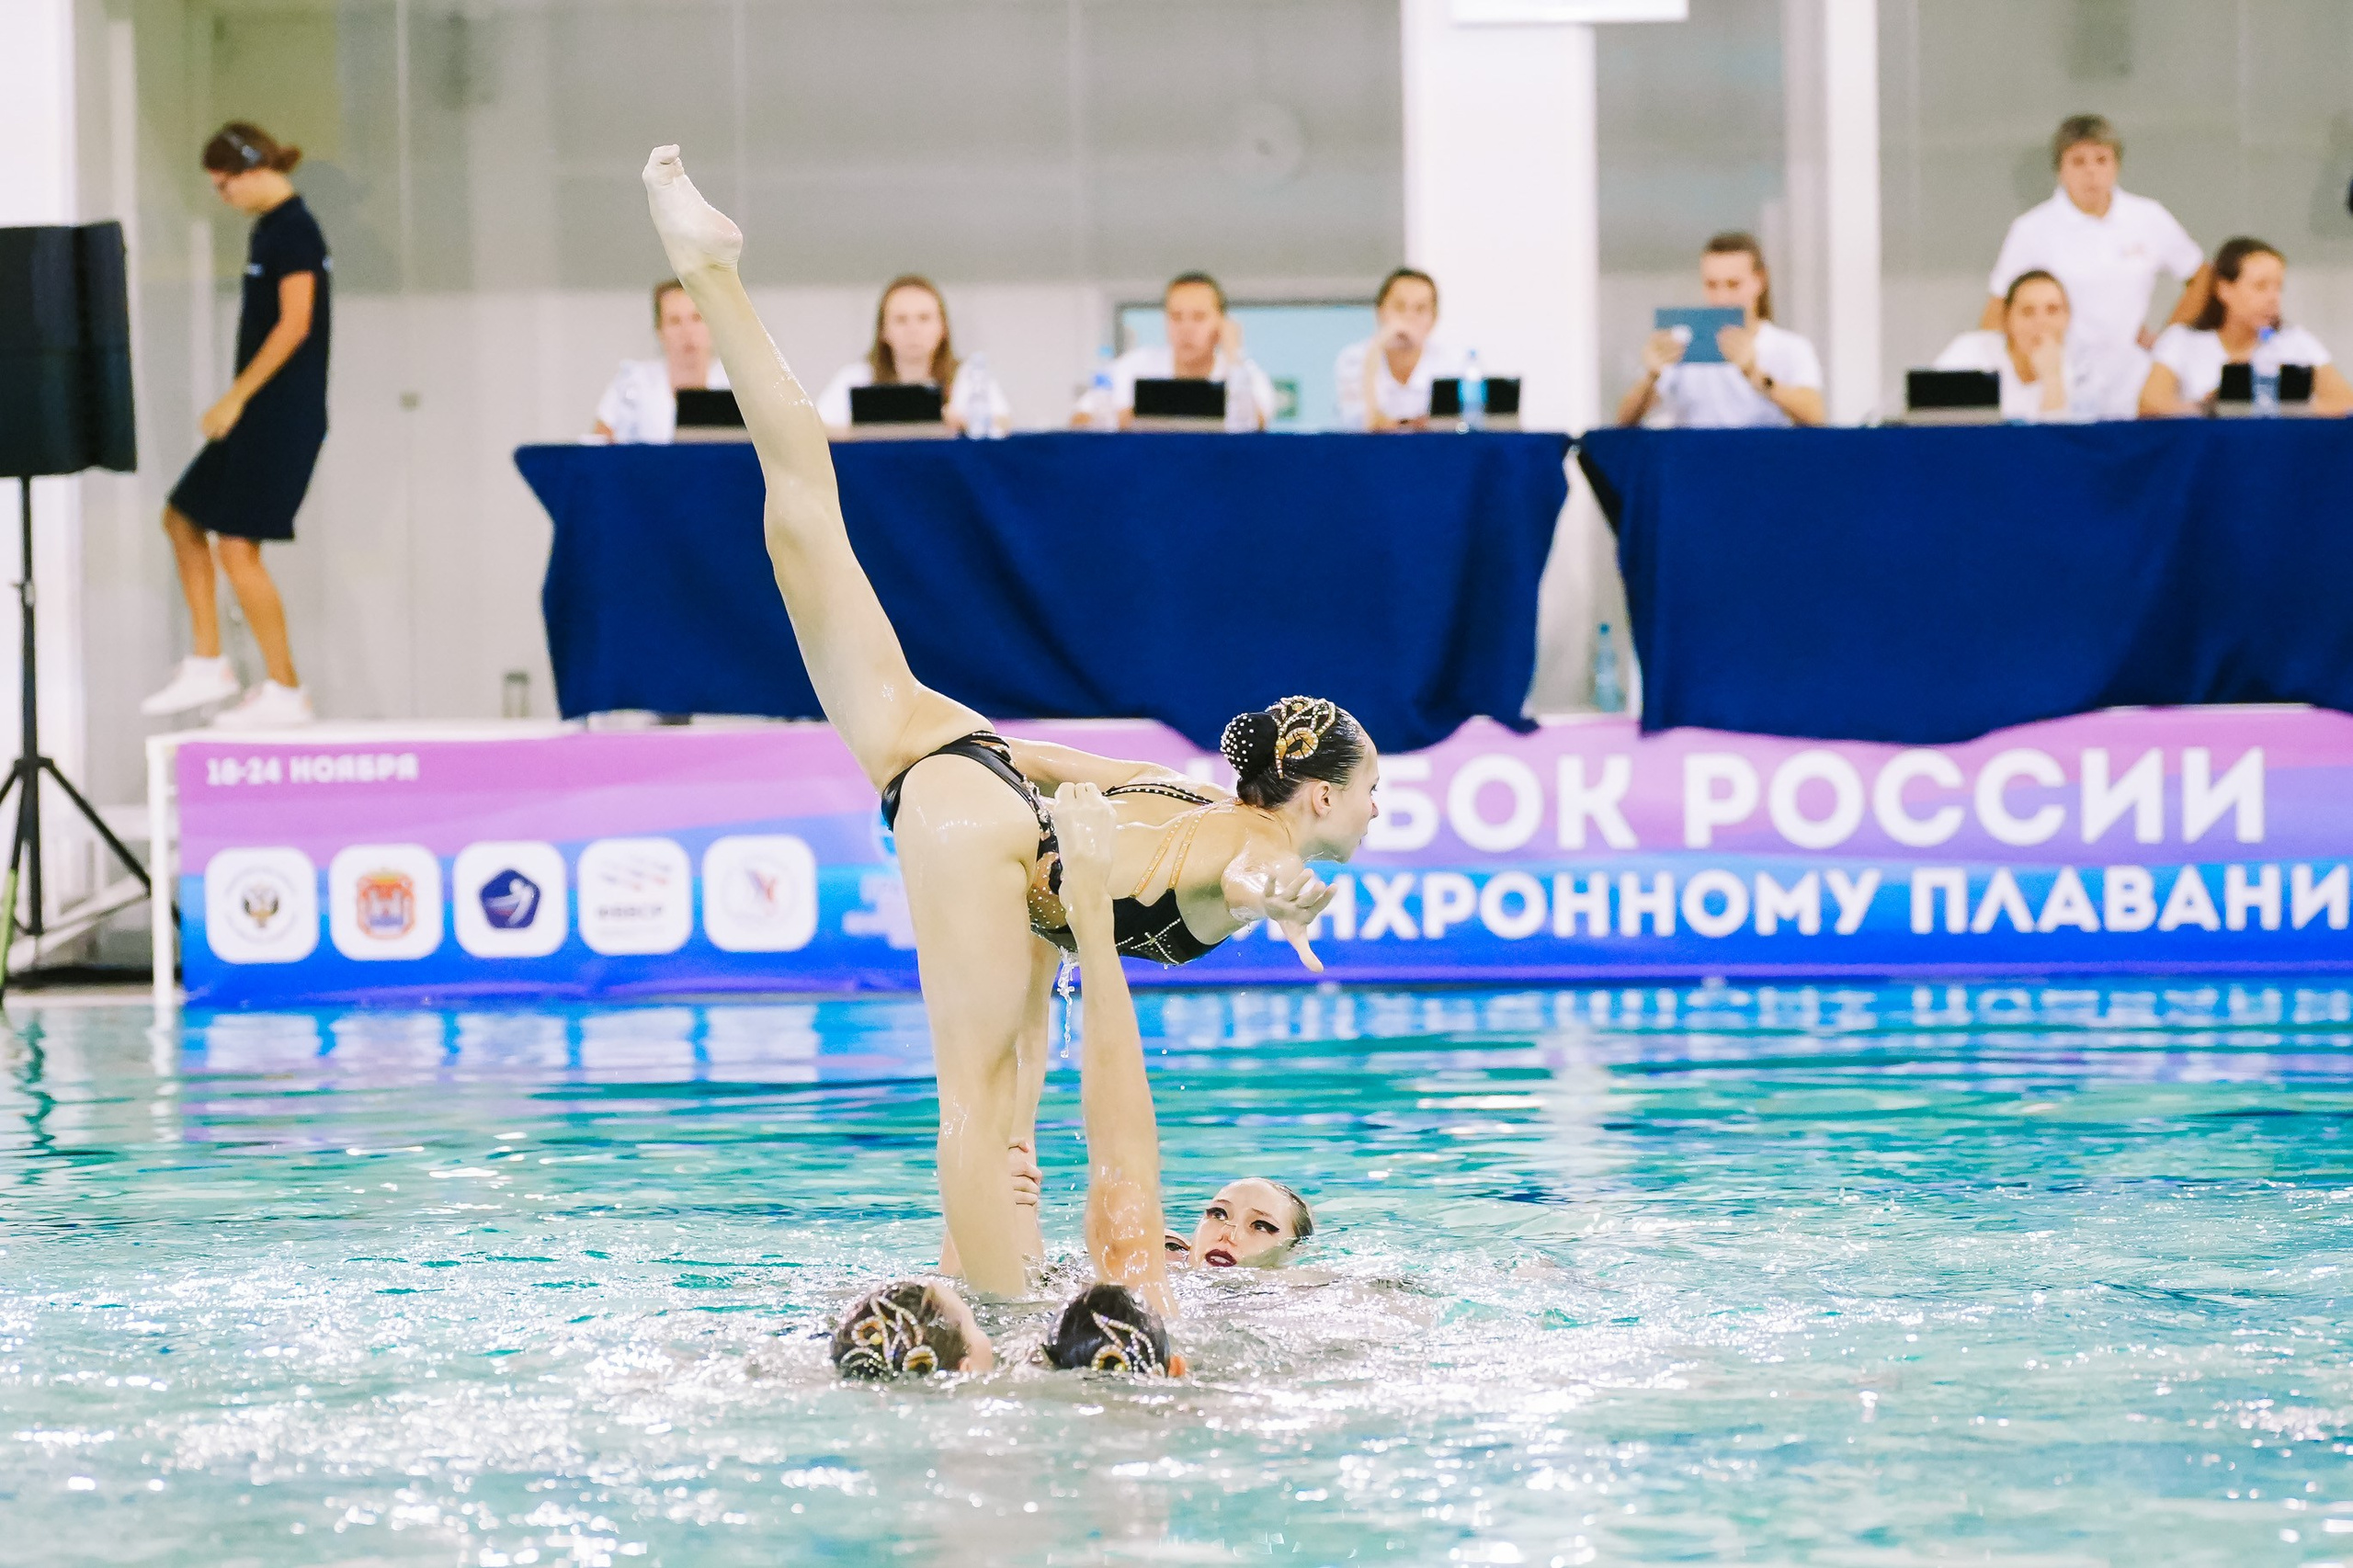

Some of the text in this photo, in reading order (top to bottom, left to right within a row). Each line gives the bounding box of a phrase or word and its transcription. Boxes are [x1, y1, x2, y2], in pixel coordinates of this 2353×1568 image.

[289, 753, 420, 783] НОЯБРЯ
[1187, 746, 2267, 853] БОК РОССИИ
[1232, 868, 1883, 941] НХРОННОМУ
